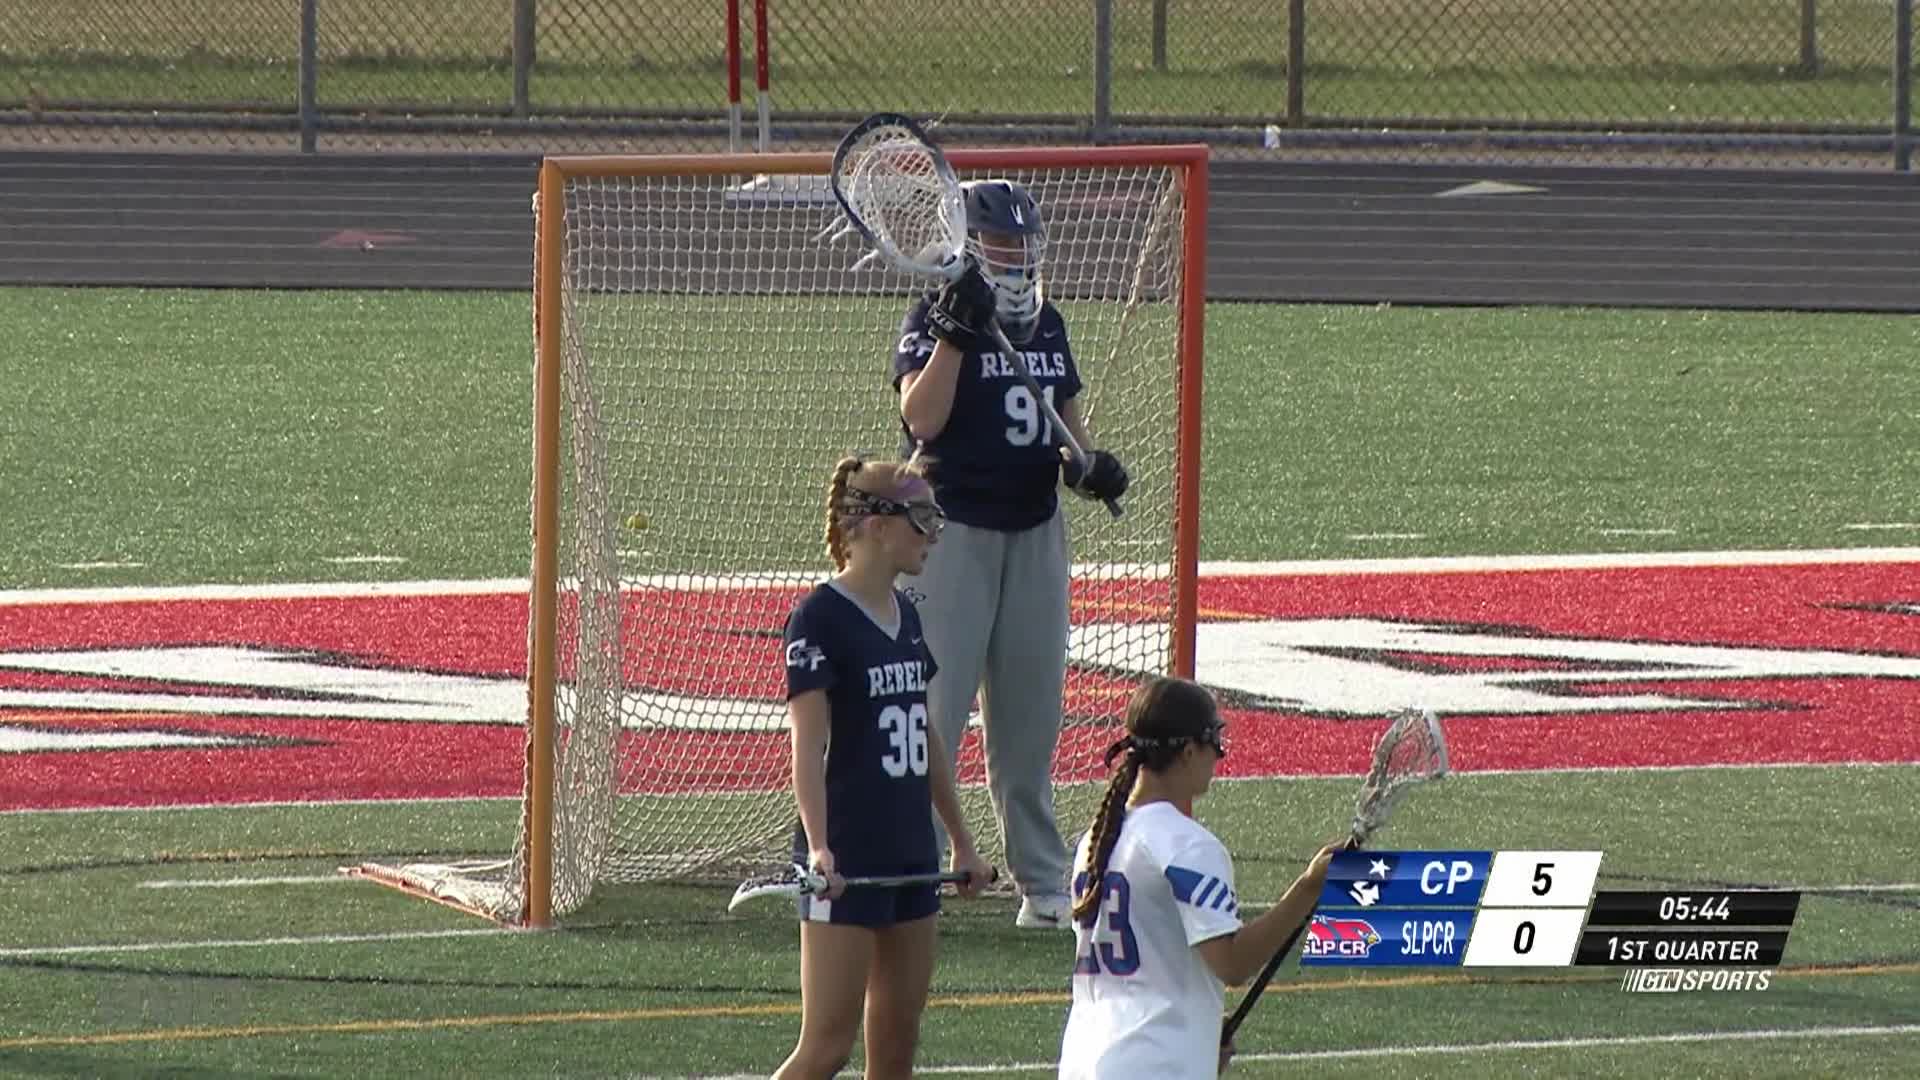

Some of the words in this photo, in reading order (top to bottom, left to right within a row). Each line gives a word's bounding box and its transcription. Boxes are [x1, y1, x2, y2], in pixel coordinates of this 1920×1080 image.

[1004, 385, 1054, 446] 91
[867, 660, 927, 698] REBEL
[878, 703, 928, 778] 36
